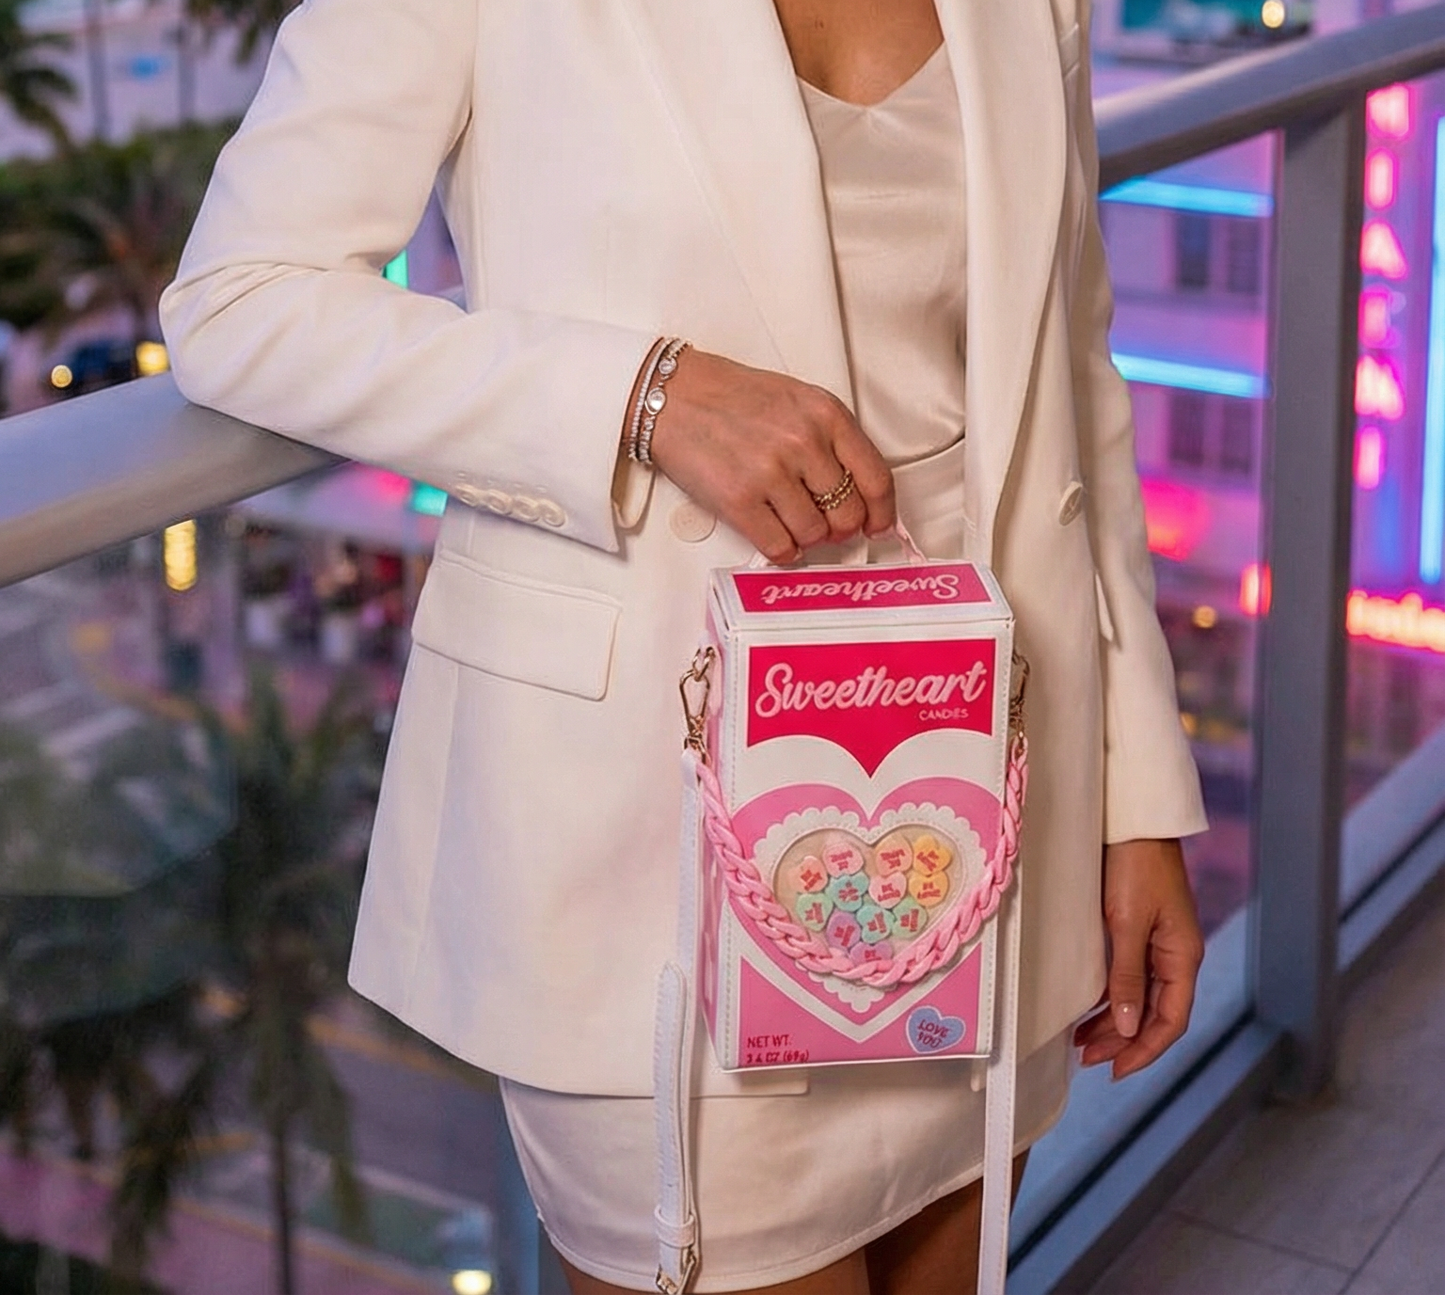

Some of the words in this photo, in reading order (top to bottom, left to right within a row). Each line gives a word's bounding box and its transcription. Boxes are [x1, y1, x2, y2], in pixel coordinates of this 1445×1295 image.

[761, 573, 960, 605] Sweetheart
[755, 661, 987, 718] Sweetheart
[917, 1019, 951, 1038] LOVE
[747, 1035, 770, 1048] NET
[917, 1031, 942, 1048] YOU
